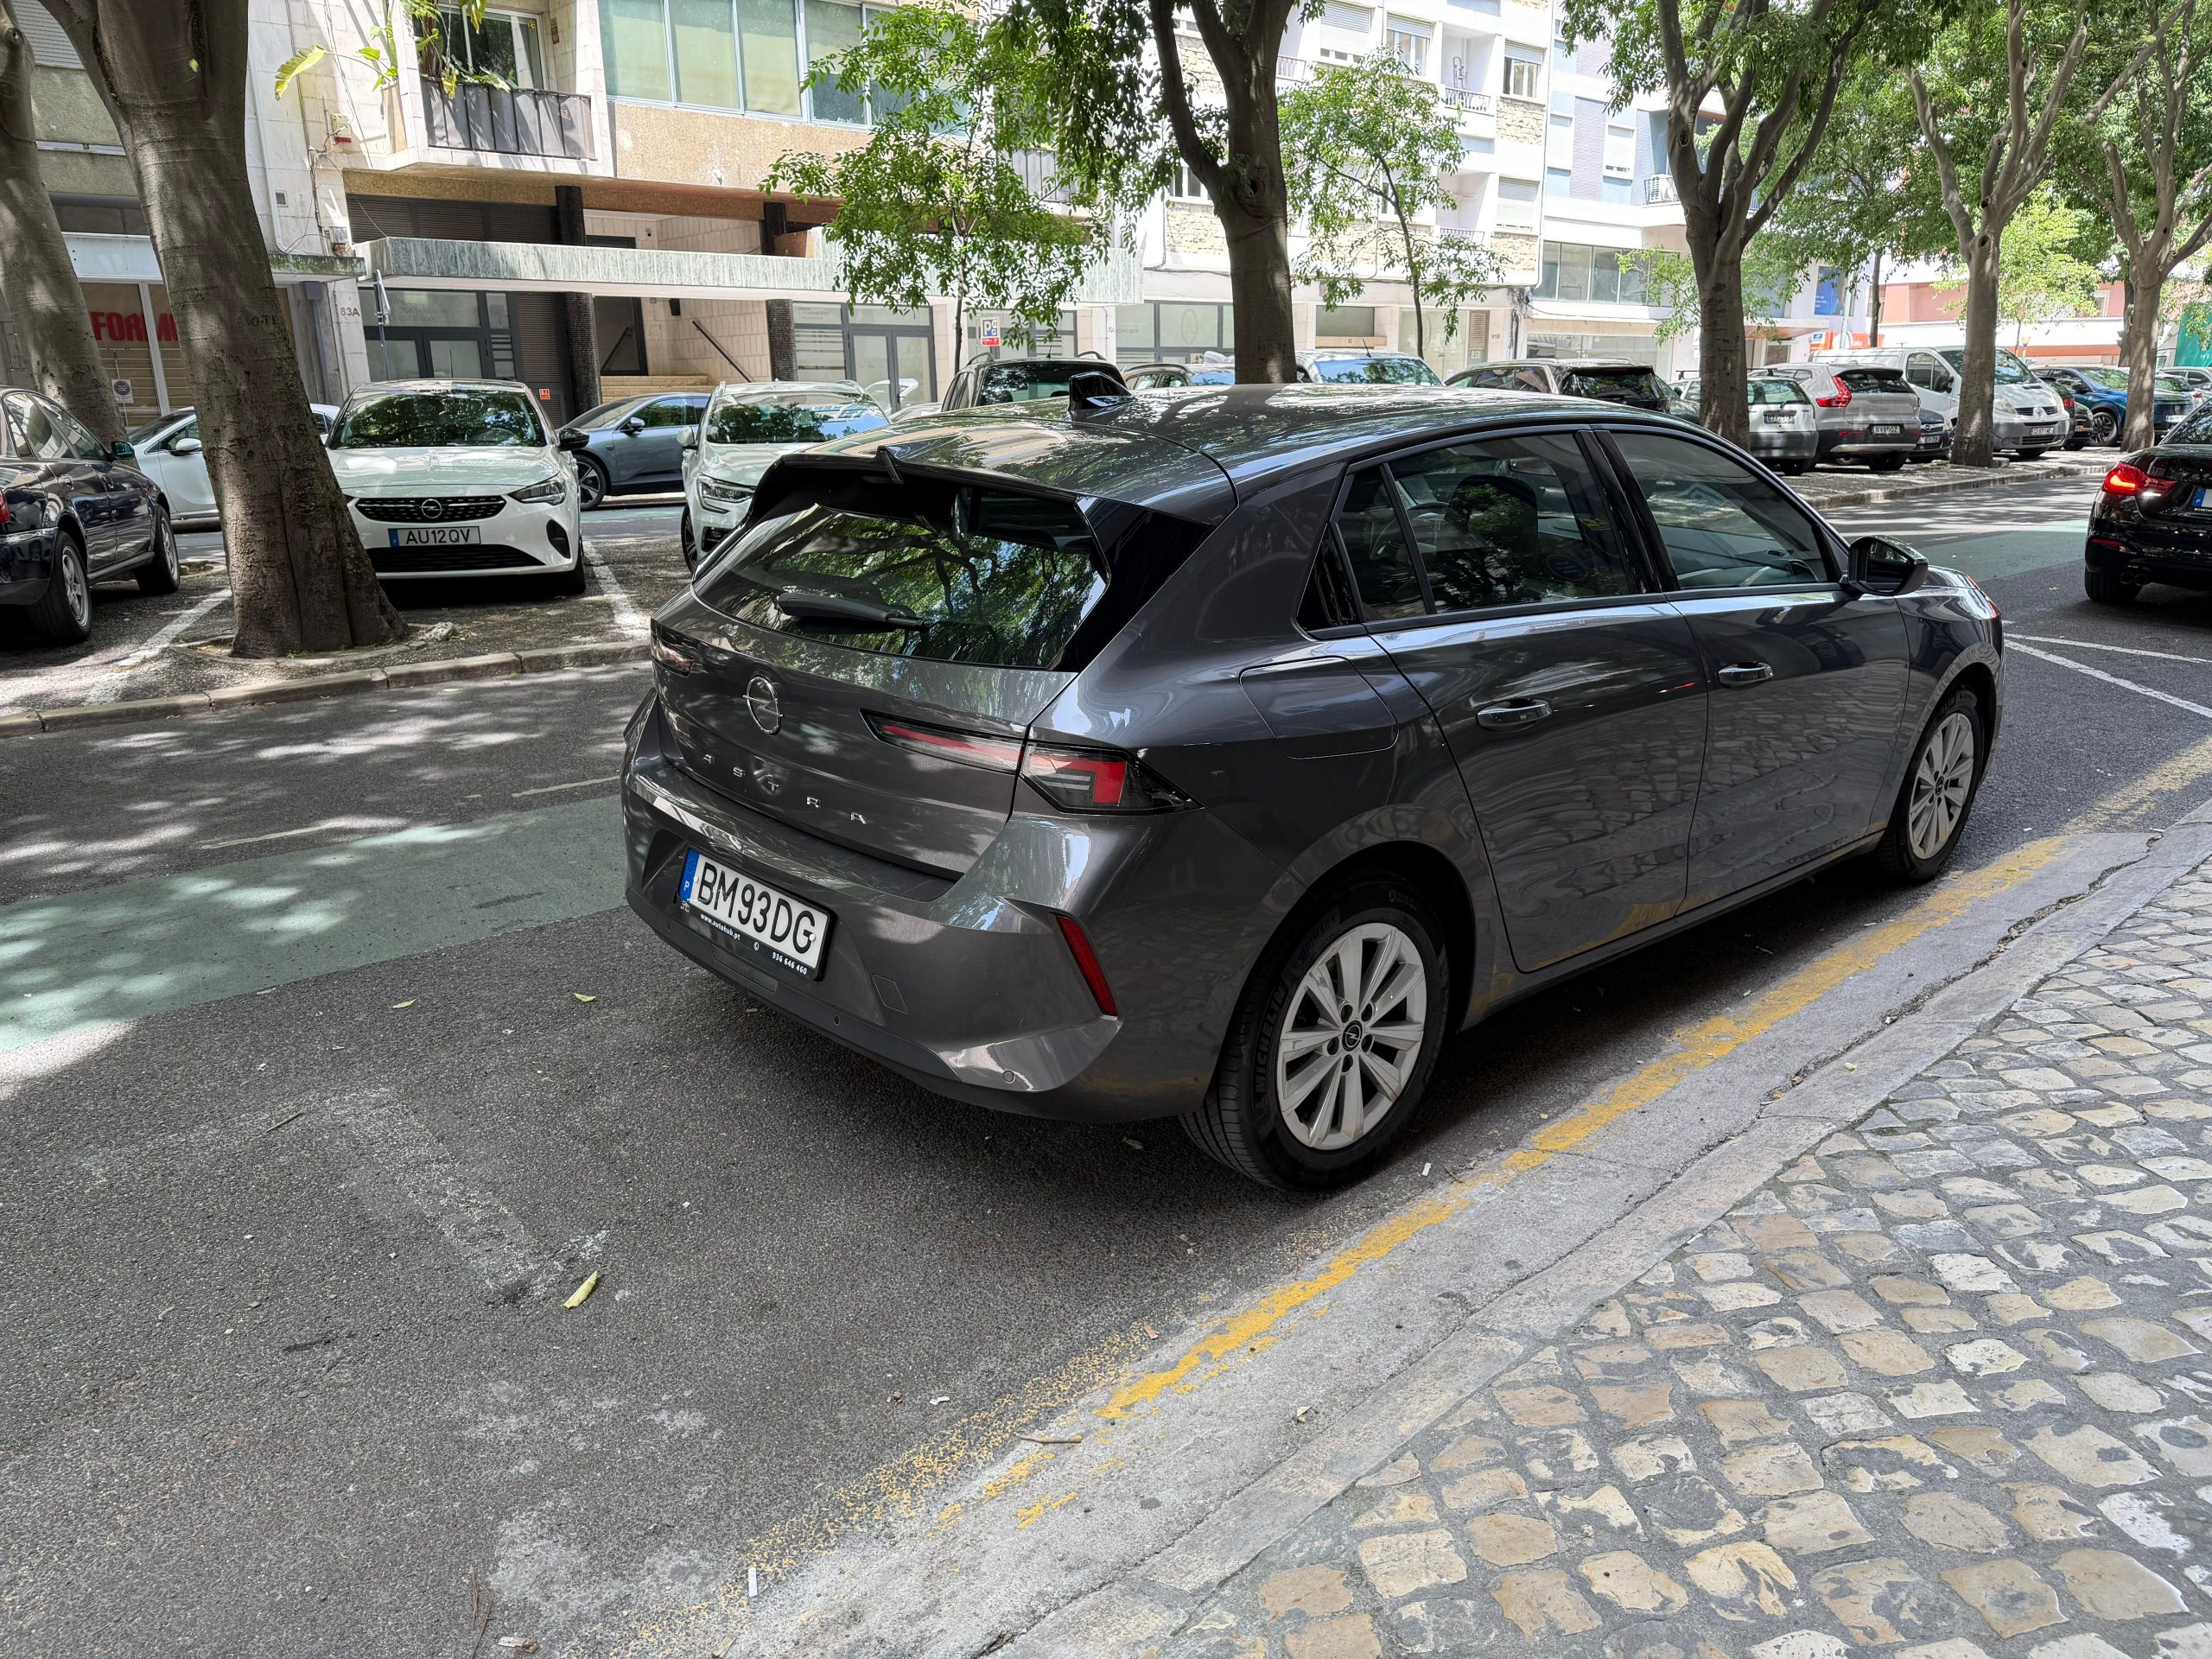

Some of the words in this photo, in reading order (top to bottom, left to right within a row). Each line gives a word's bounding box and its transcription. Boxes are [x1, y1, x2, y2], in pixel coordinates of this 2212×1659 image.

[340, 307, 360, 317] 83A
[405, 528, 470, 544] AU12QV
[703, 753, 867, 825] ASTRA
[683, 880, 690, 891] P
[697, 861, 816, 955] BM93DG
[700, 913, 741, 941] www.autohub.pt
[772, 951, 783, 963] 936
[784, 957, 795, 969] 646
[796, 963, 807, 975] 460
[1254, 982, 1287, 1093] MICHELIN
